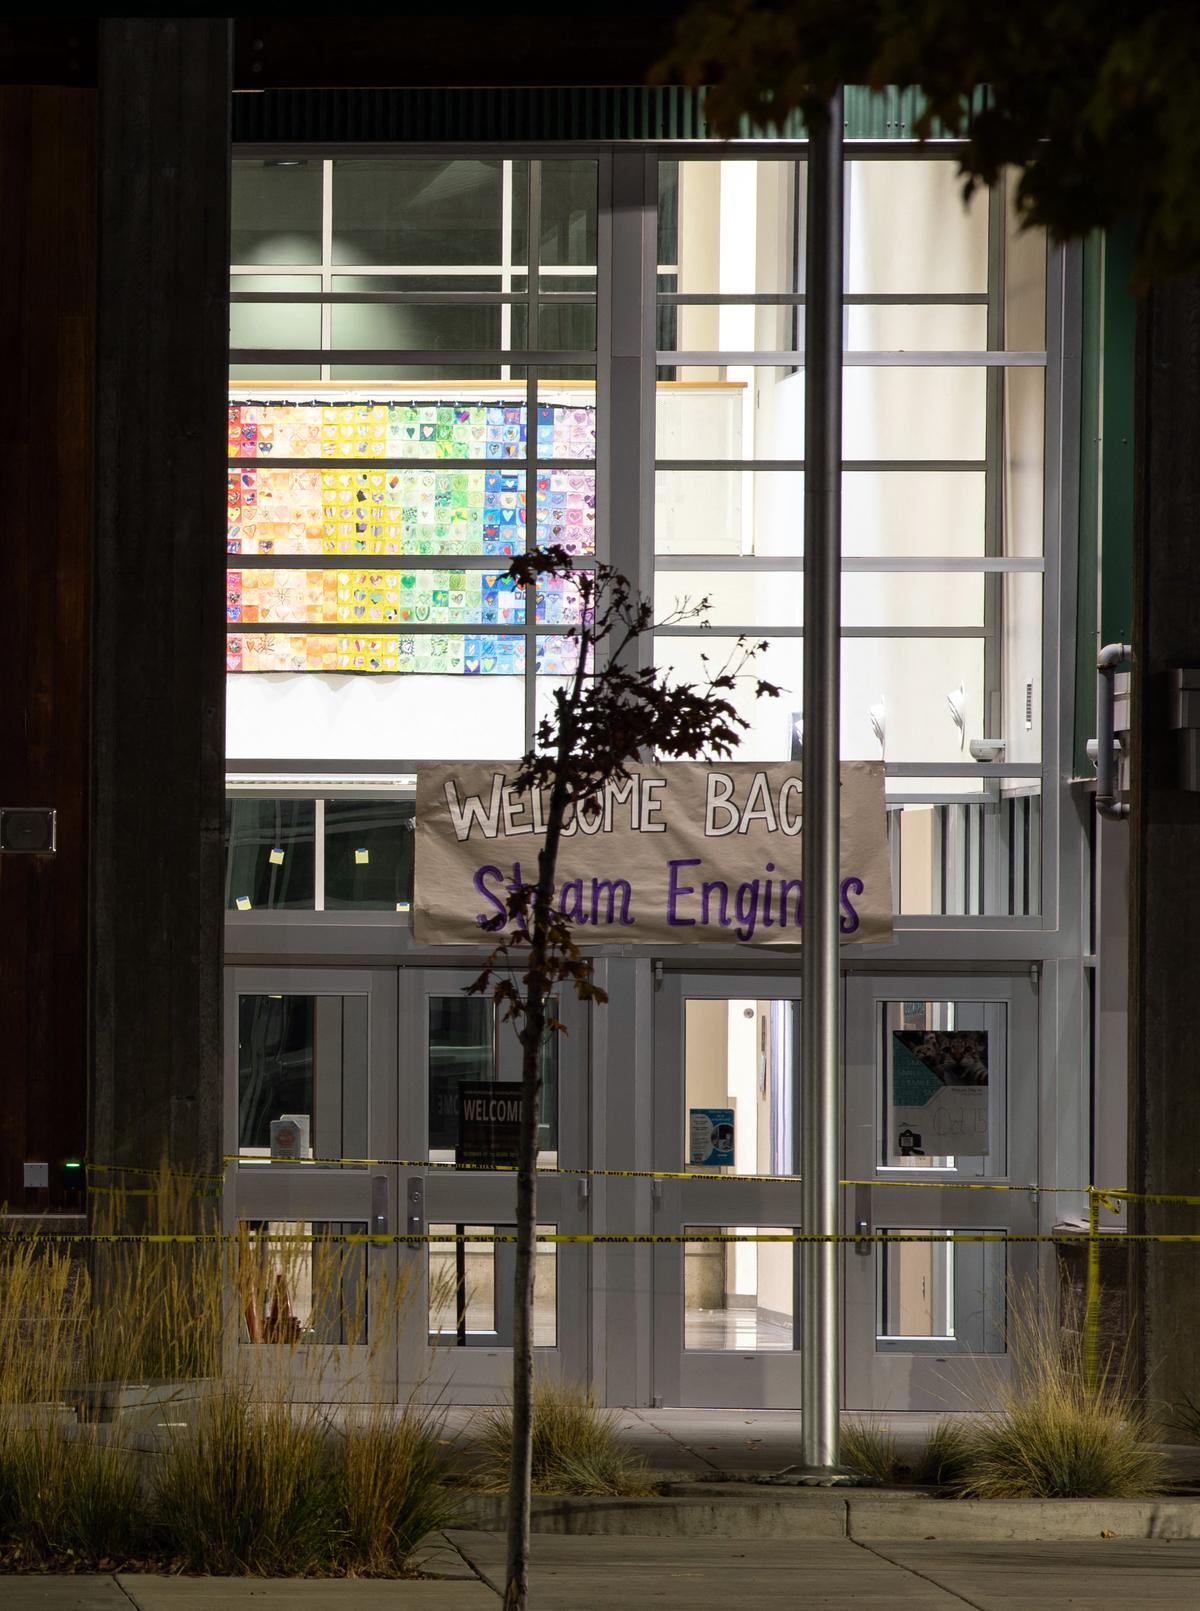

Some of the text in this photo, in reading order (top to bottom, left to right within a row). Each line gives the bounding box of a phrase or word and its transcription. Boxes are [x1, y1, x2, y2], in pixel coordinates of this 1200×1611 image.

[704, 771, 803, 837] BAC
[472, 858, 865, 942] Stam Engins
